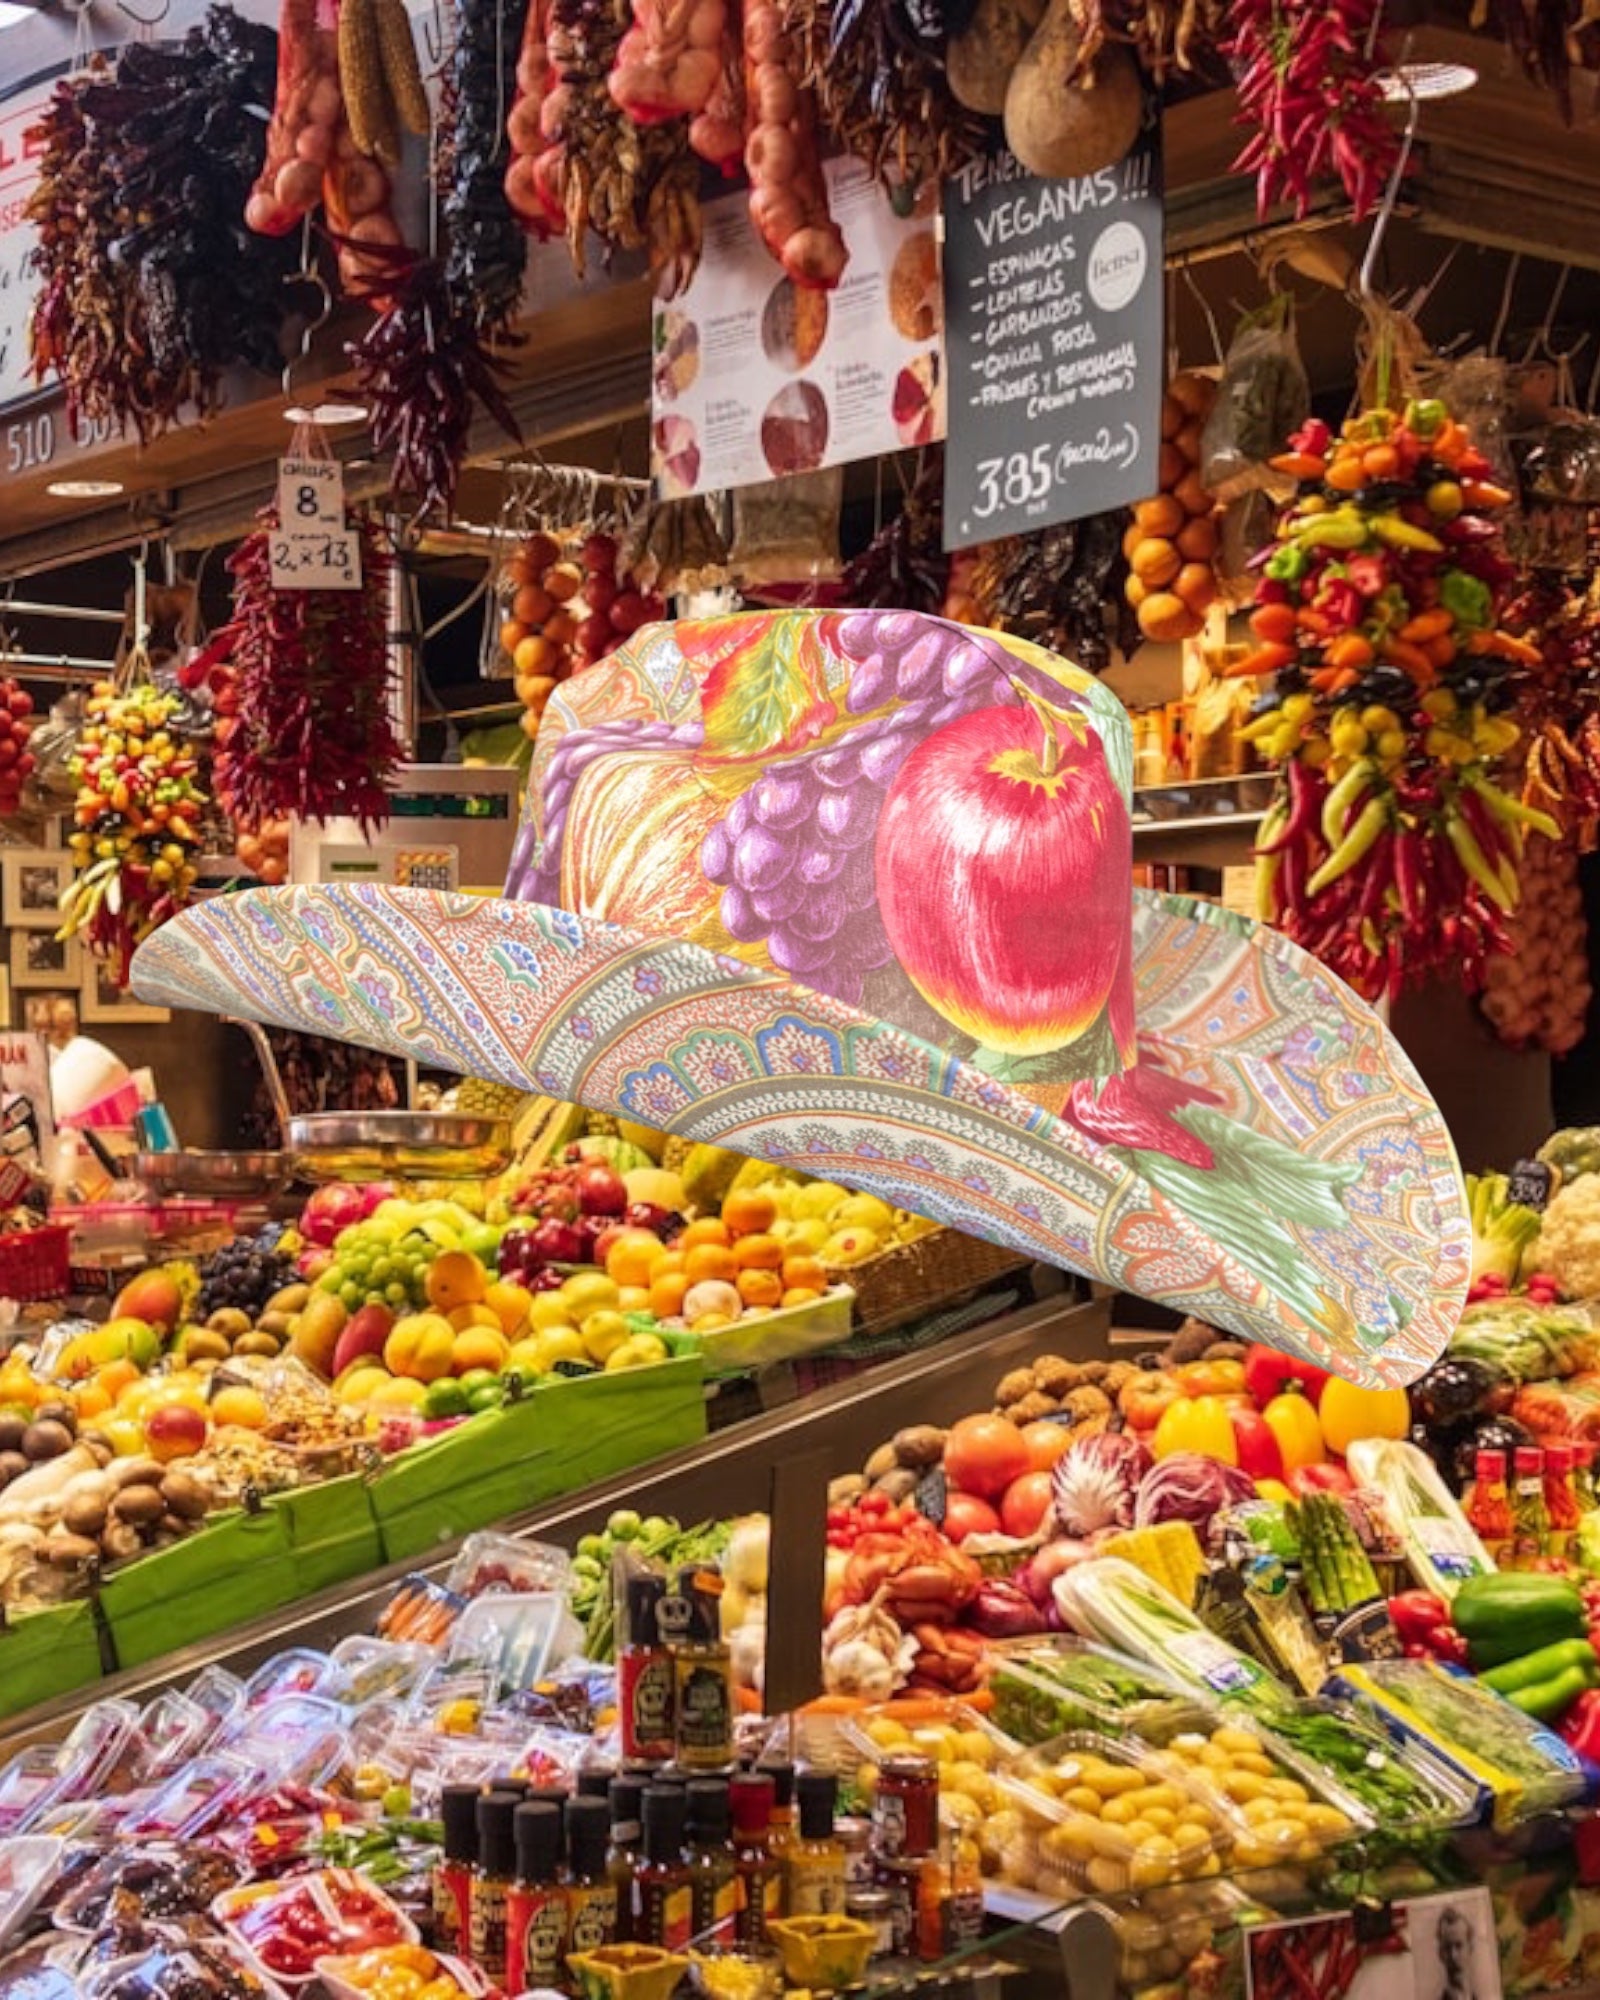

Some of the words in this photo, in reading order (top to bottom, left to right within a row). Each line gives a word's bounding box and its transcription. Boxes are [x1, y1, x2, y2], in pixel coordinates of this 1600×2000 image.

[8, 414, 53, 472] 510
[297, 486, 318, 516] 8
[317, 541, 350, 567] 13
